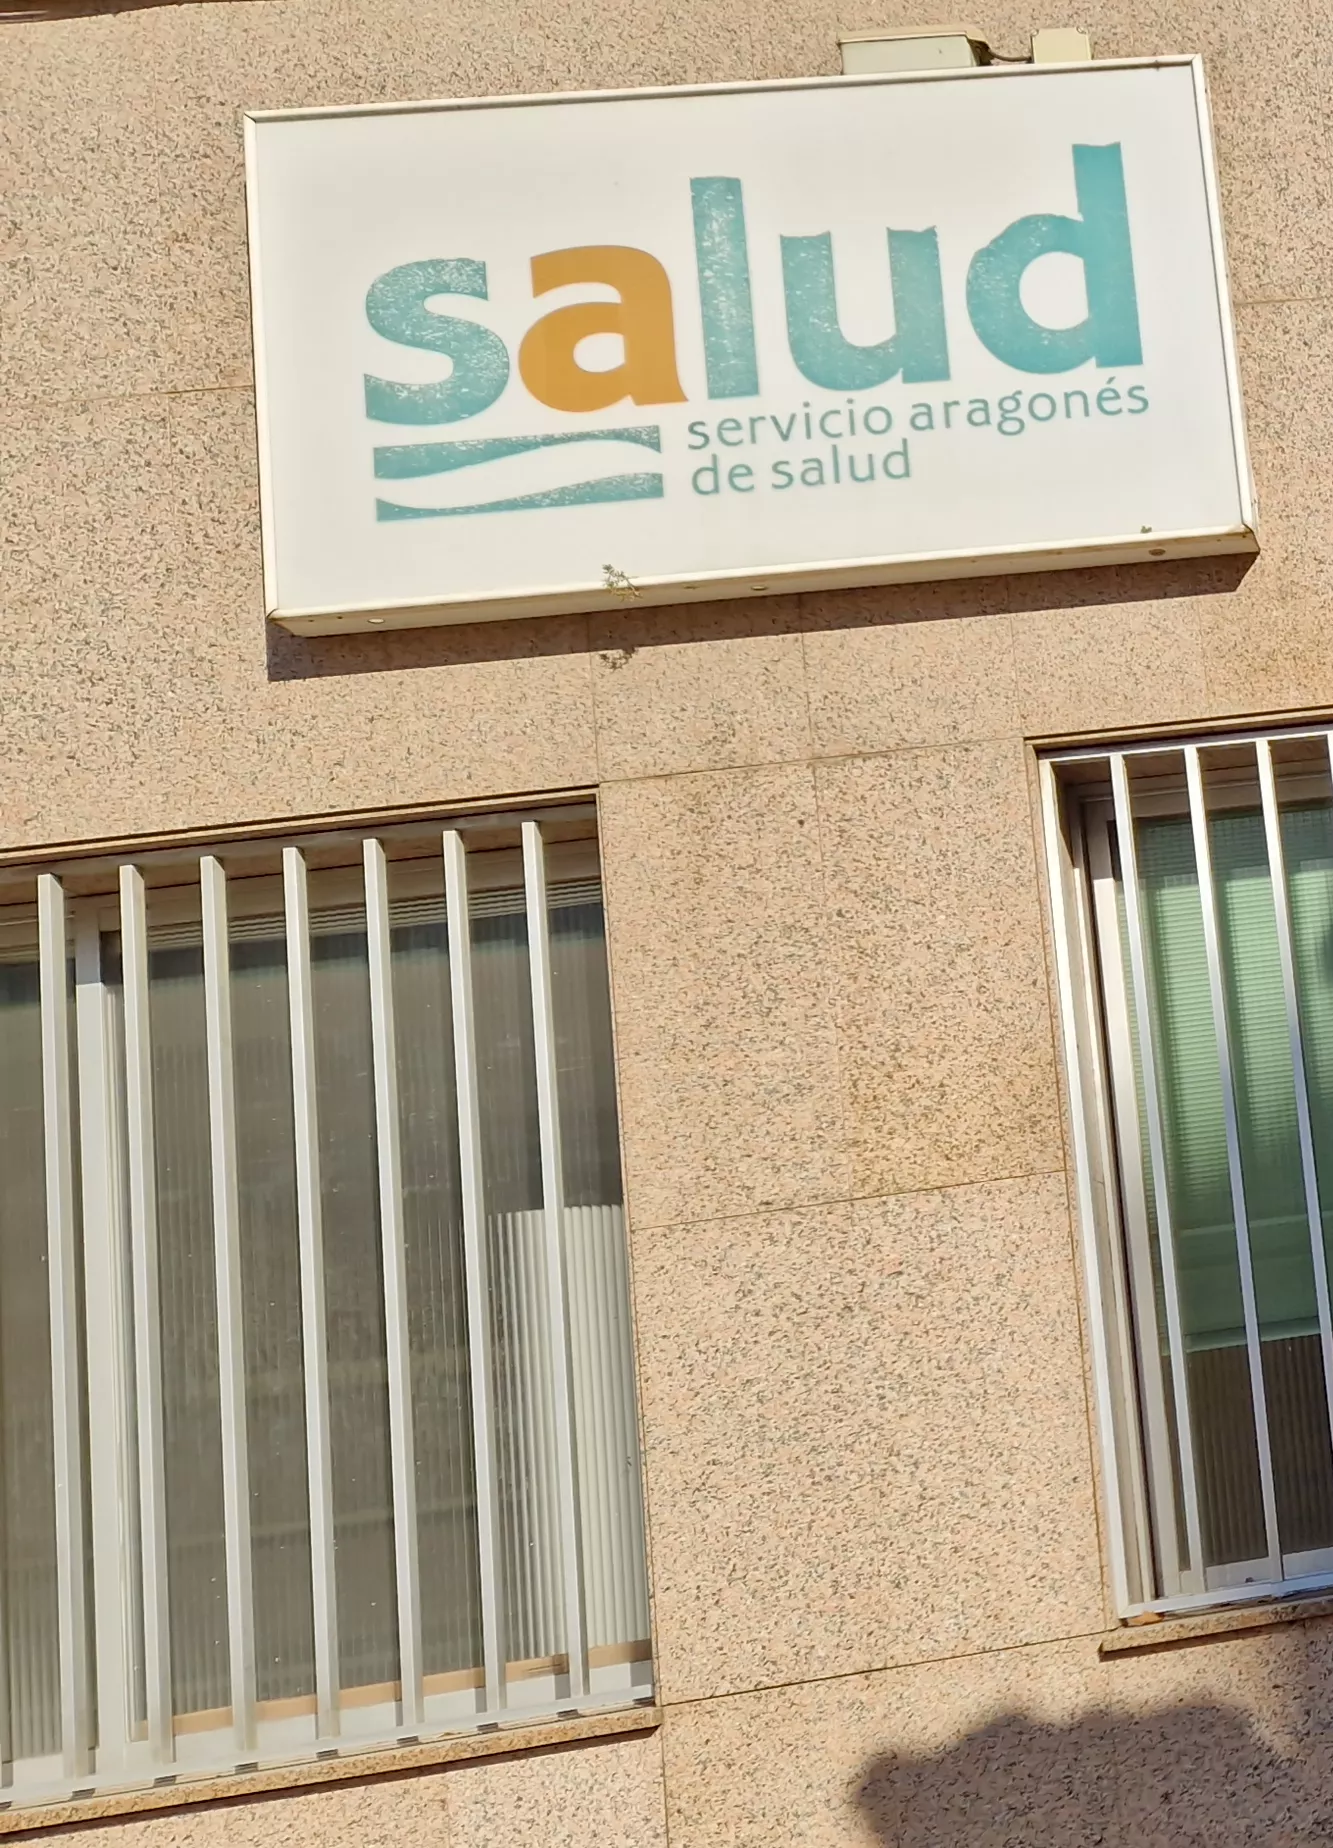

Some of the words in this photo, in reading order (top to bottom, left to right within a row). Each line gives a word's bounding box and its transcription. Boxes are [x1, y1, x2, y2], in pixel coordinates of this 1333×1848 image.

[363, 142, 1143, 426] salud
[687, 403, 893, 450] servicio
[909, 376, 1150, 436] aragonés
[691, 453, 756, 496] de
[770, 438, 912, 490] salud
